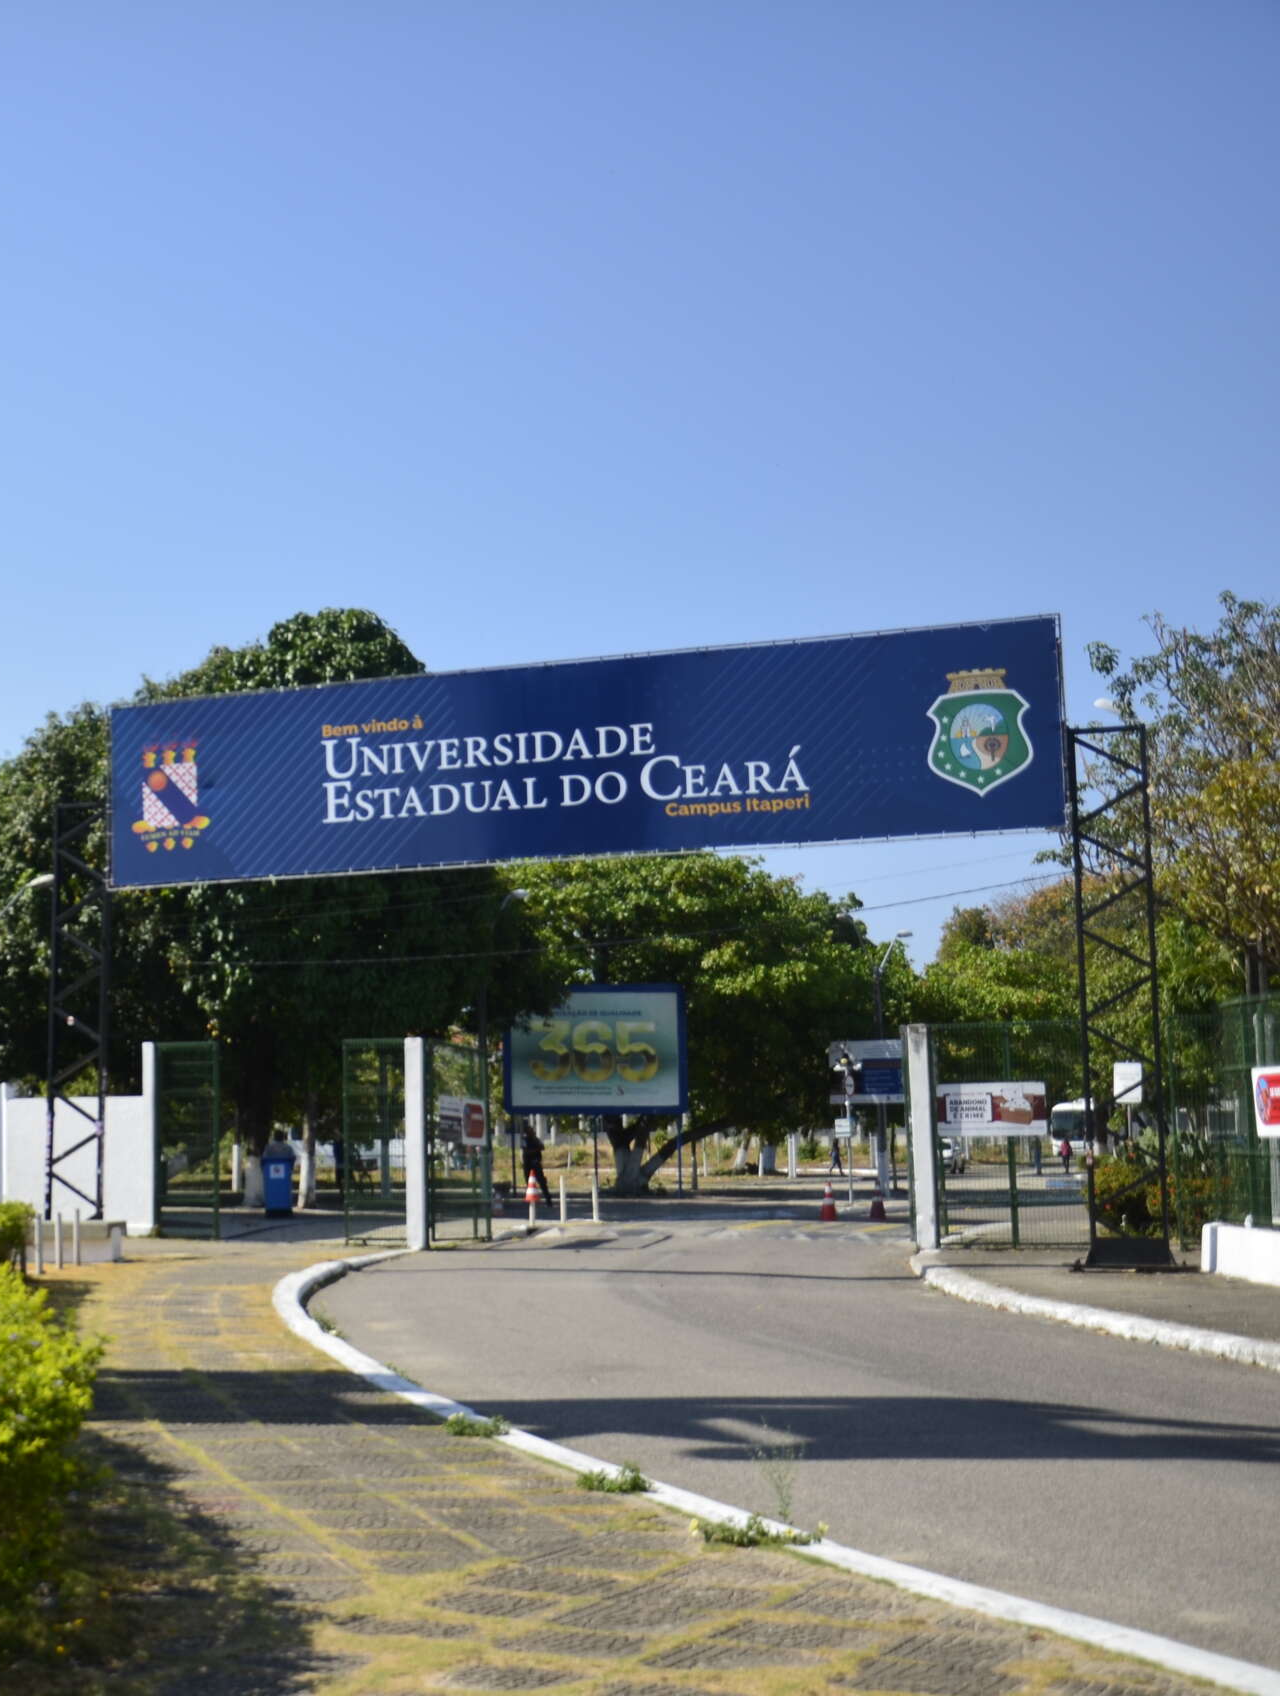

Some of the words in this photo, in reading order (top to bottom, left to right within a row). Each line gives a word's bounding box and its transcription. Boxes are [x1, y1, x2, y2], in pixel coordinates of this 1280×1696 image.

[321, 723, 359, 738] Bem
[361, 719, 409, 735] vindo
[411, 714, 424, 729] à
[559, 771, 628, 807] DO
[665, 801, 742, 817] Campus
[746, 793, 811, 811] Itaperi
[529, 1020, 658, 1083] 365
